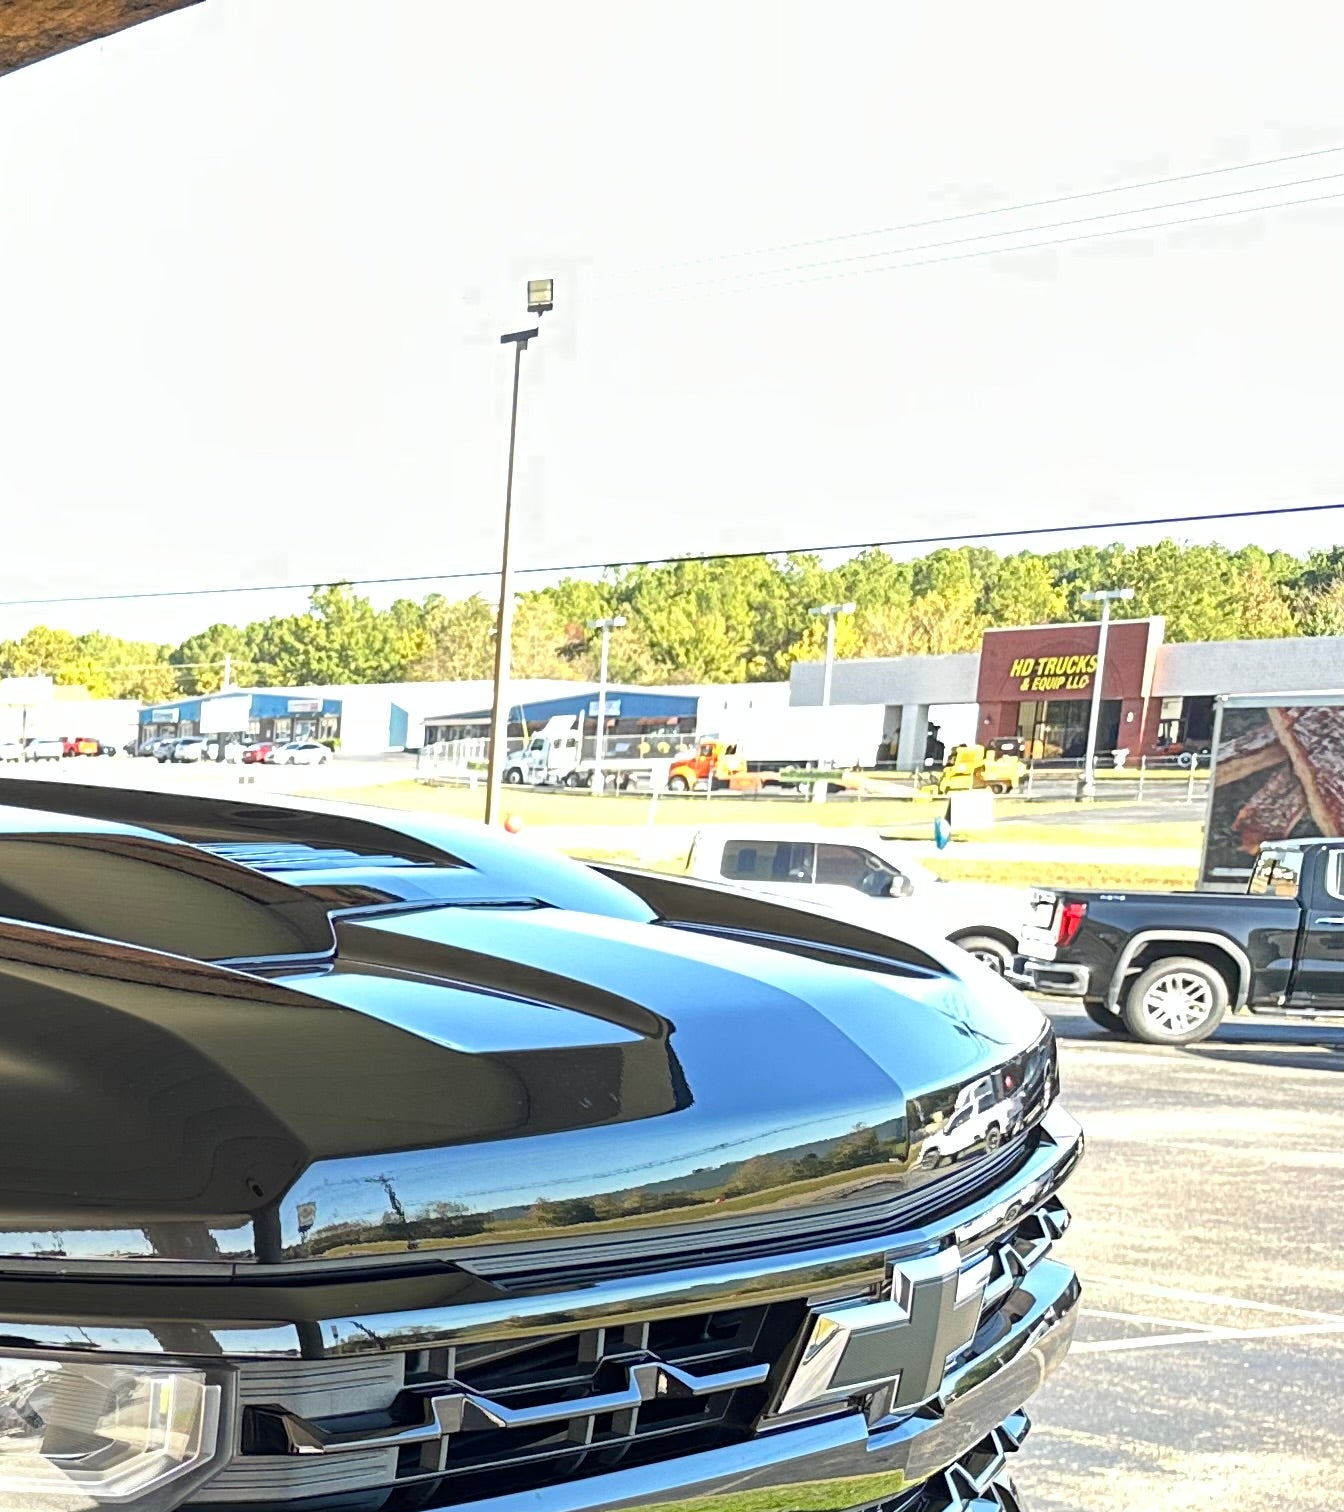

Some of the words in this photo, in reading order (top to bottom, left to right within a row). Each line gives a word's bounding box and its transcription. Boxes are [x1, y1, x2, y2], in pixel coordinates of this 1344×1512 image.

[1010, 658, 1035, 677] HD
[1037, 655, 1098, 676] TRUCKS
[1020, 677, 1030, 691] &
[1031, 676, 1065, 691] EQUIP
[1066, 675, 1090, 690] LLC
